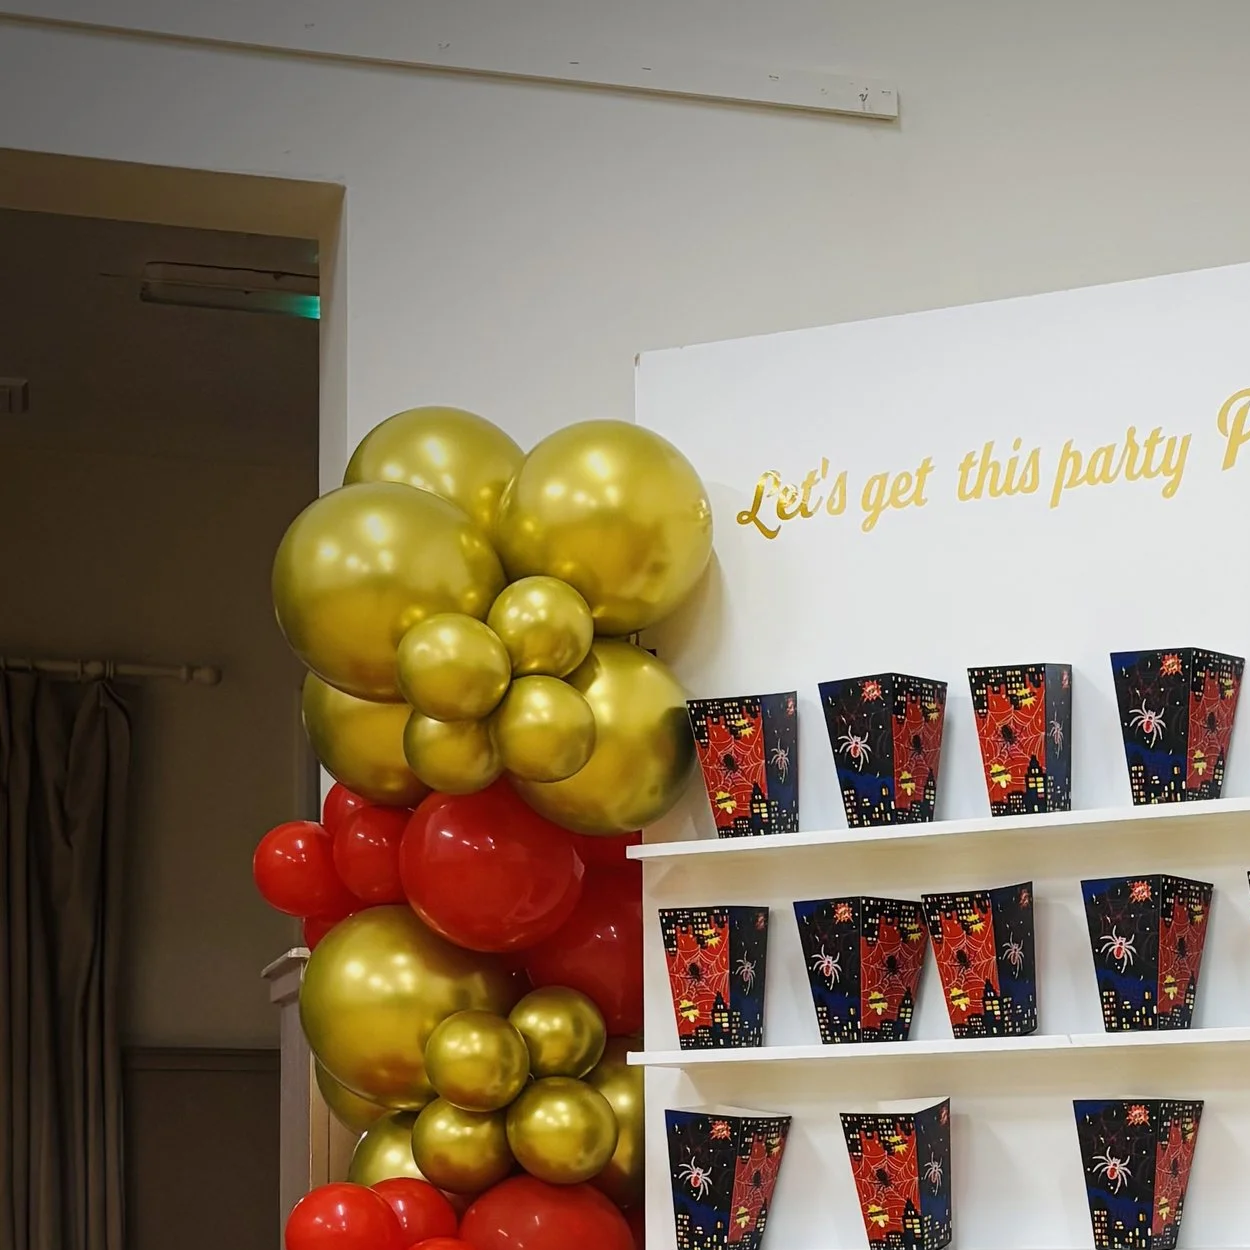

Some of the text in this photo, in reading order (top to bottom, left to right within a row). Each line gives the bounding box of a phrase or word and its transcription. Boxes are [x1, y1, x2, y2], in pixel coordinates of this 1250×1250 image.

[736, 458, 846, 540] Let's
[861, 458, 932, 532] get
[957, 439, 1039, 501] this
[1050, 427, 1190, 508] party
